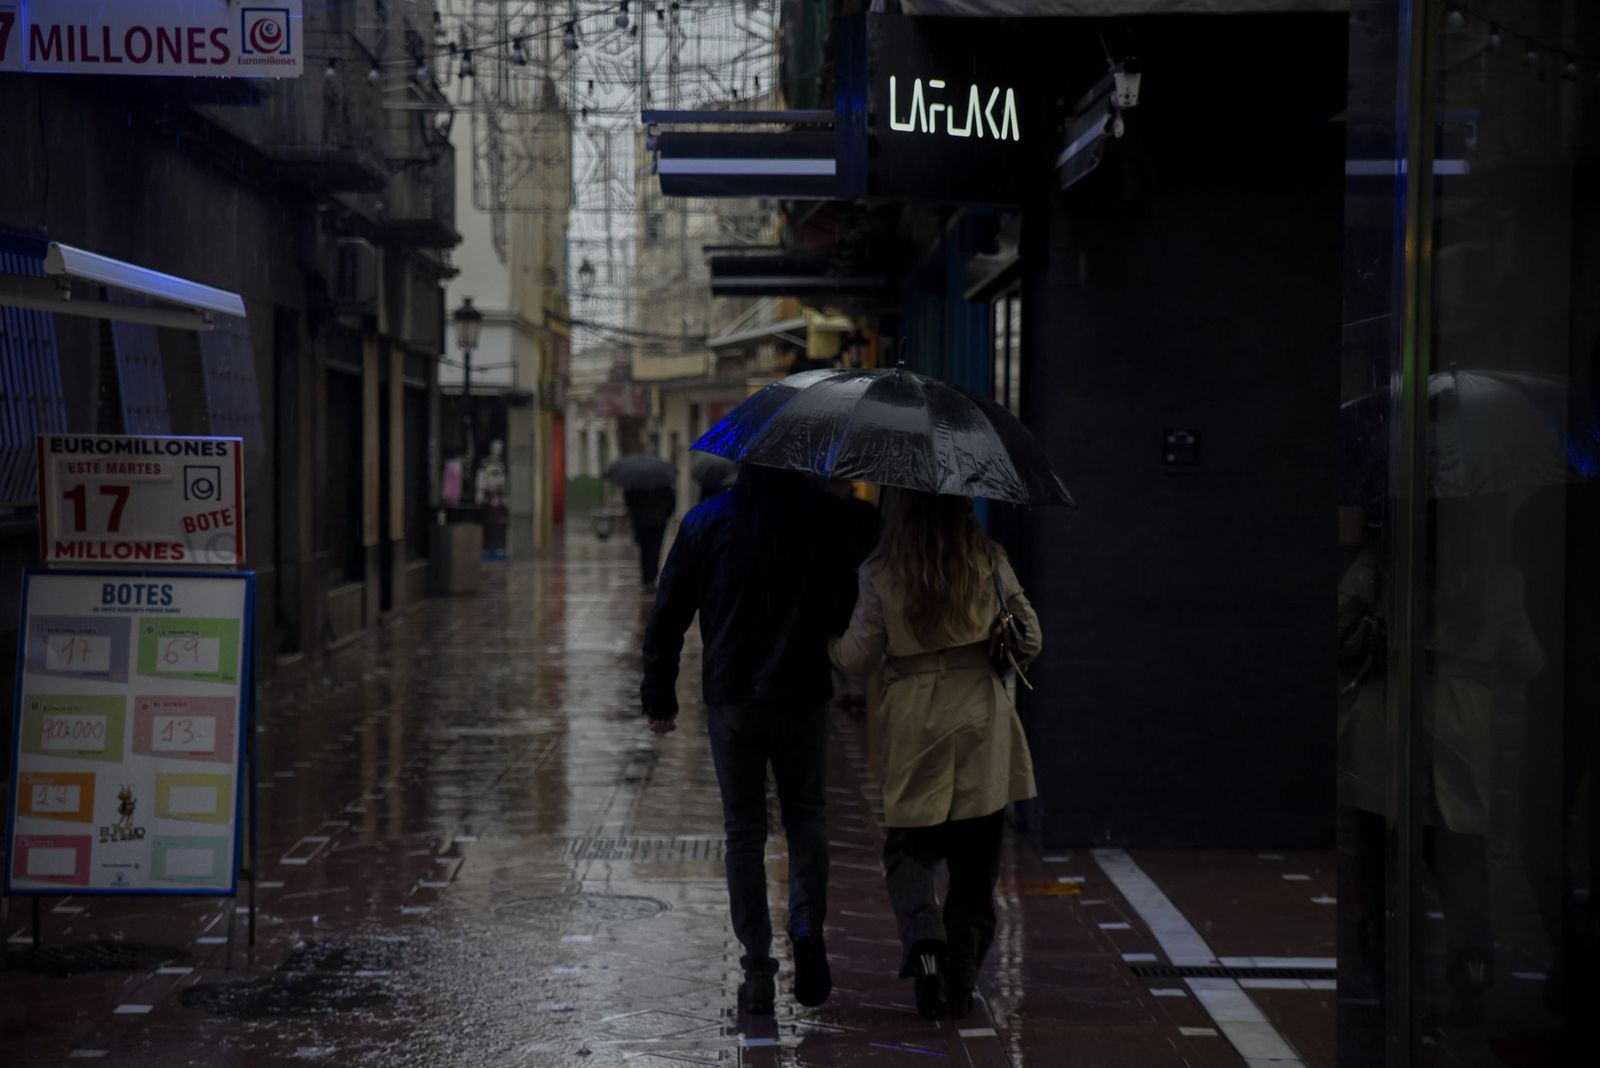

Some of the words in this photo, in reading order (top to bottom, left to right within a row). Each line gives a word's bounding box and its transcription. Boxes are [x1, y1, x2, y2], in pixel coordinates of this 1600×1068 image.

[29, 24, 231, 65] MILLONES
[237, 56, 297, 66] Euromillones
[51, 438, 228, 457] EUROMILLONES
[68, 462, 100, 474] ESTE
[106, 462, 161, 475] MARTES
[63, 484, 130, 532] 17
[183, 508, 233, 534] BOTE
[55, 541, 185, 560] MILLONES
[102, 583, 173, 605] BOTES
[163, 638, 199, 664] 69
